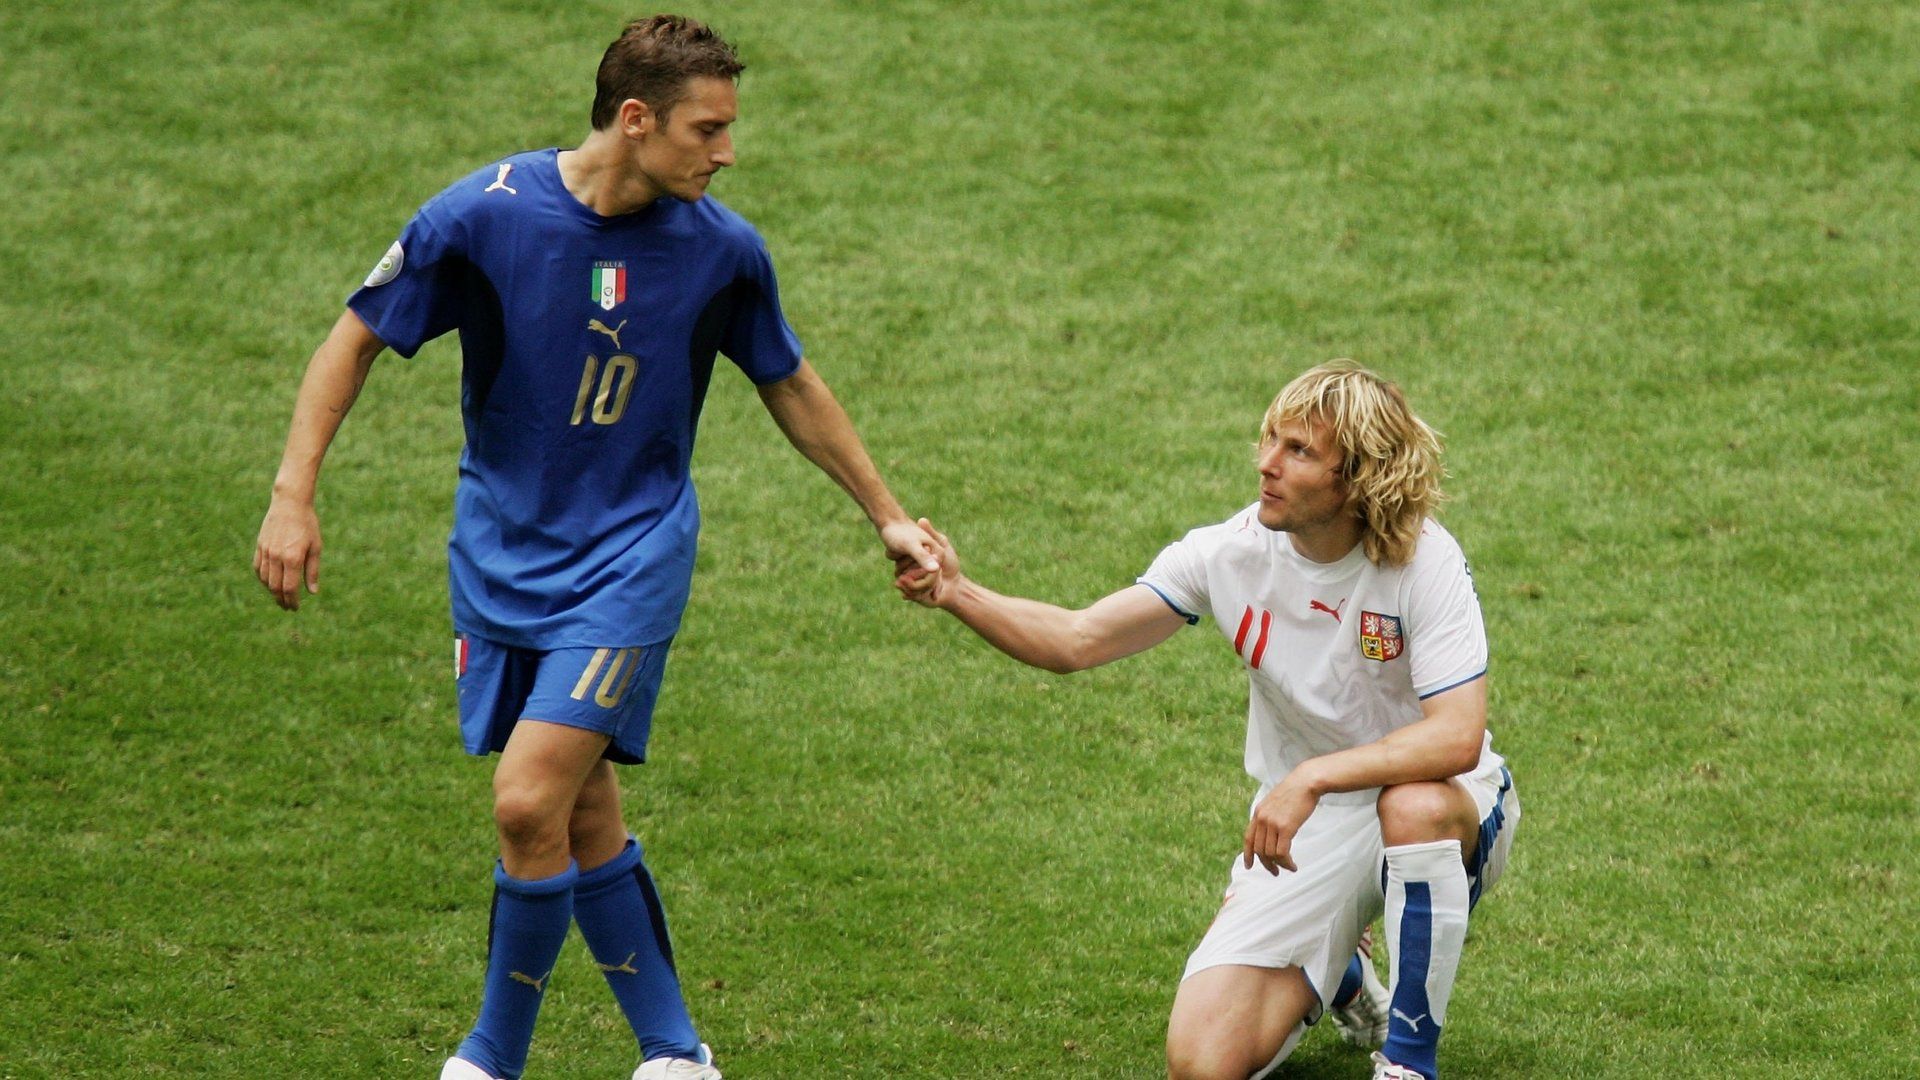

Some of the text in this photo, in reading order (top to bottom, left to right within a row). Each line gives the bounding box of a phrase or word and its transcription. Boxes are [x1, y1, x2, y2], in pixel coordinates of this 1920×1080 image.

[594, 260, 624, 268] ITALIA
[570, 354, 638, 425] 10
[1233, 604, 1273, 670] 11
[570, 647, 643, 709] 10
